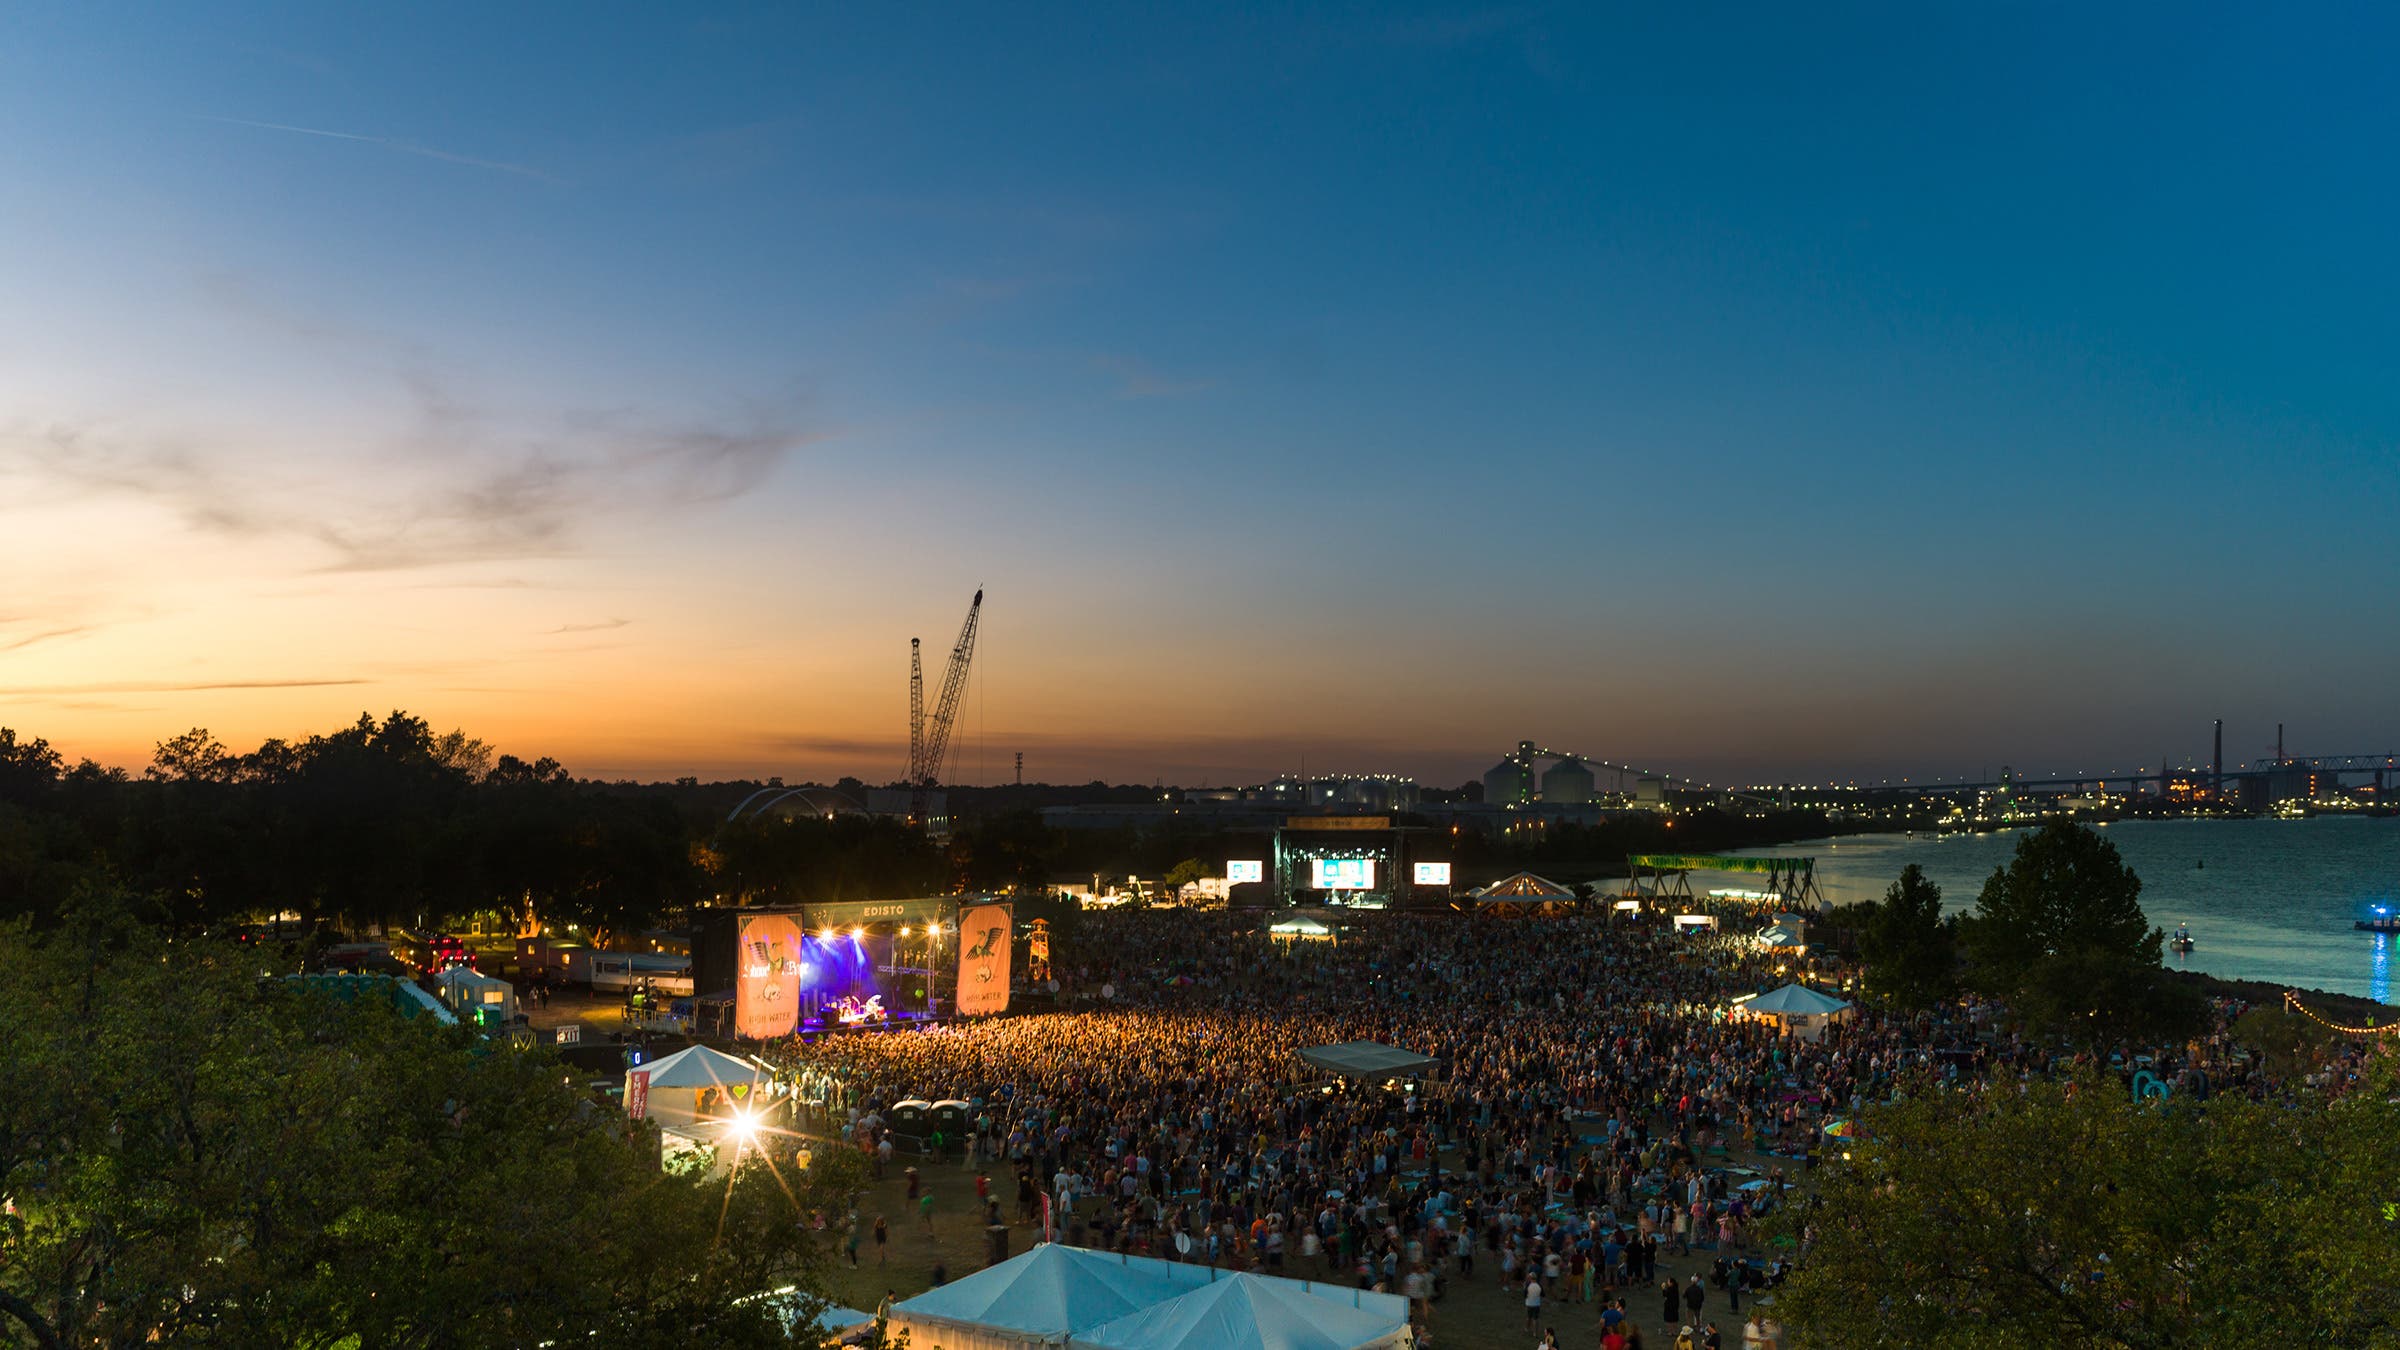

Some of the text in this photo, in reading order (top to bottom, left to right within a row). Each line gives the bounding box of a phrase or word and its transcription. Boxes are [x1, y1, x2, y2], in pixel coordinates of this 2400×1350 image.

[863, 905, 904, 917] EDISTO
[769, 1012, 791, 1022] WATER
[557, 1030, 578, 1042] EXIT
